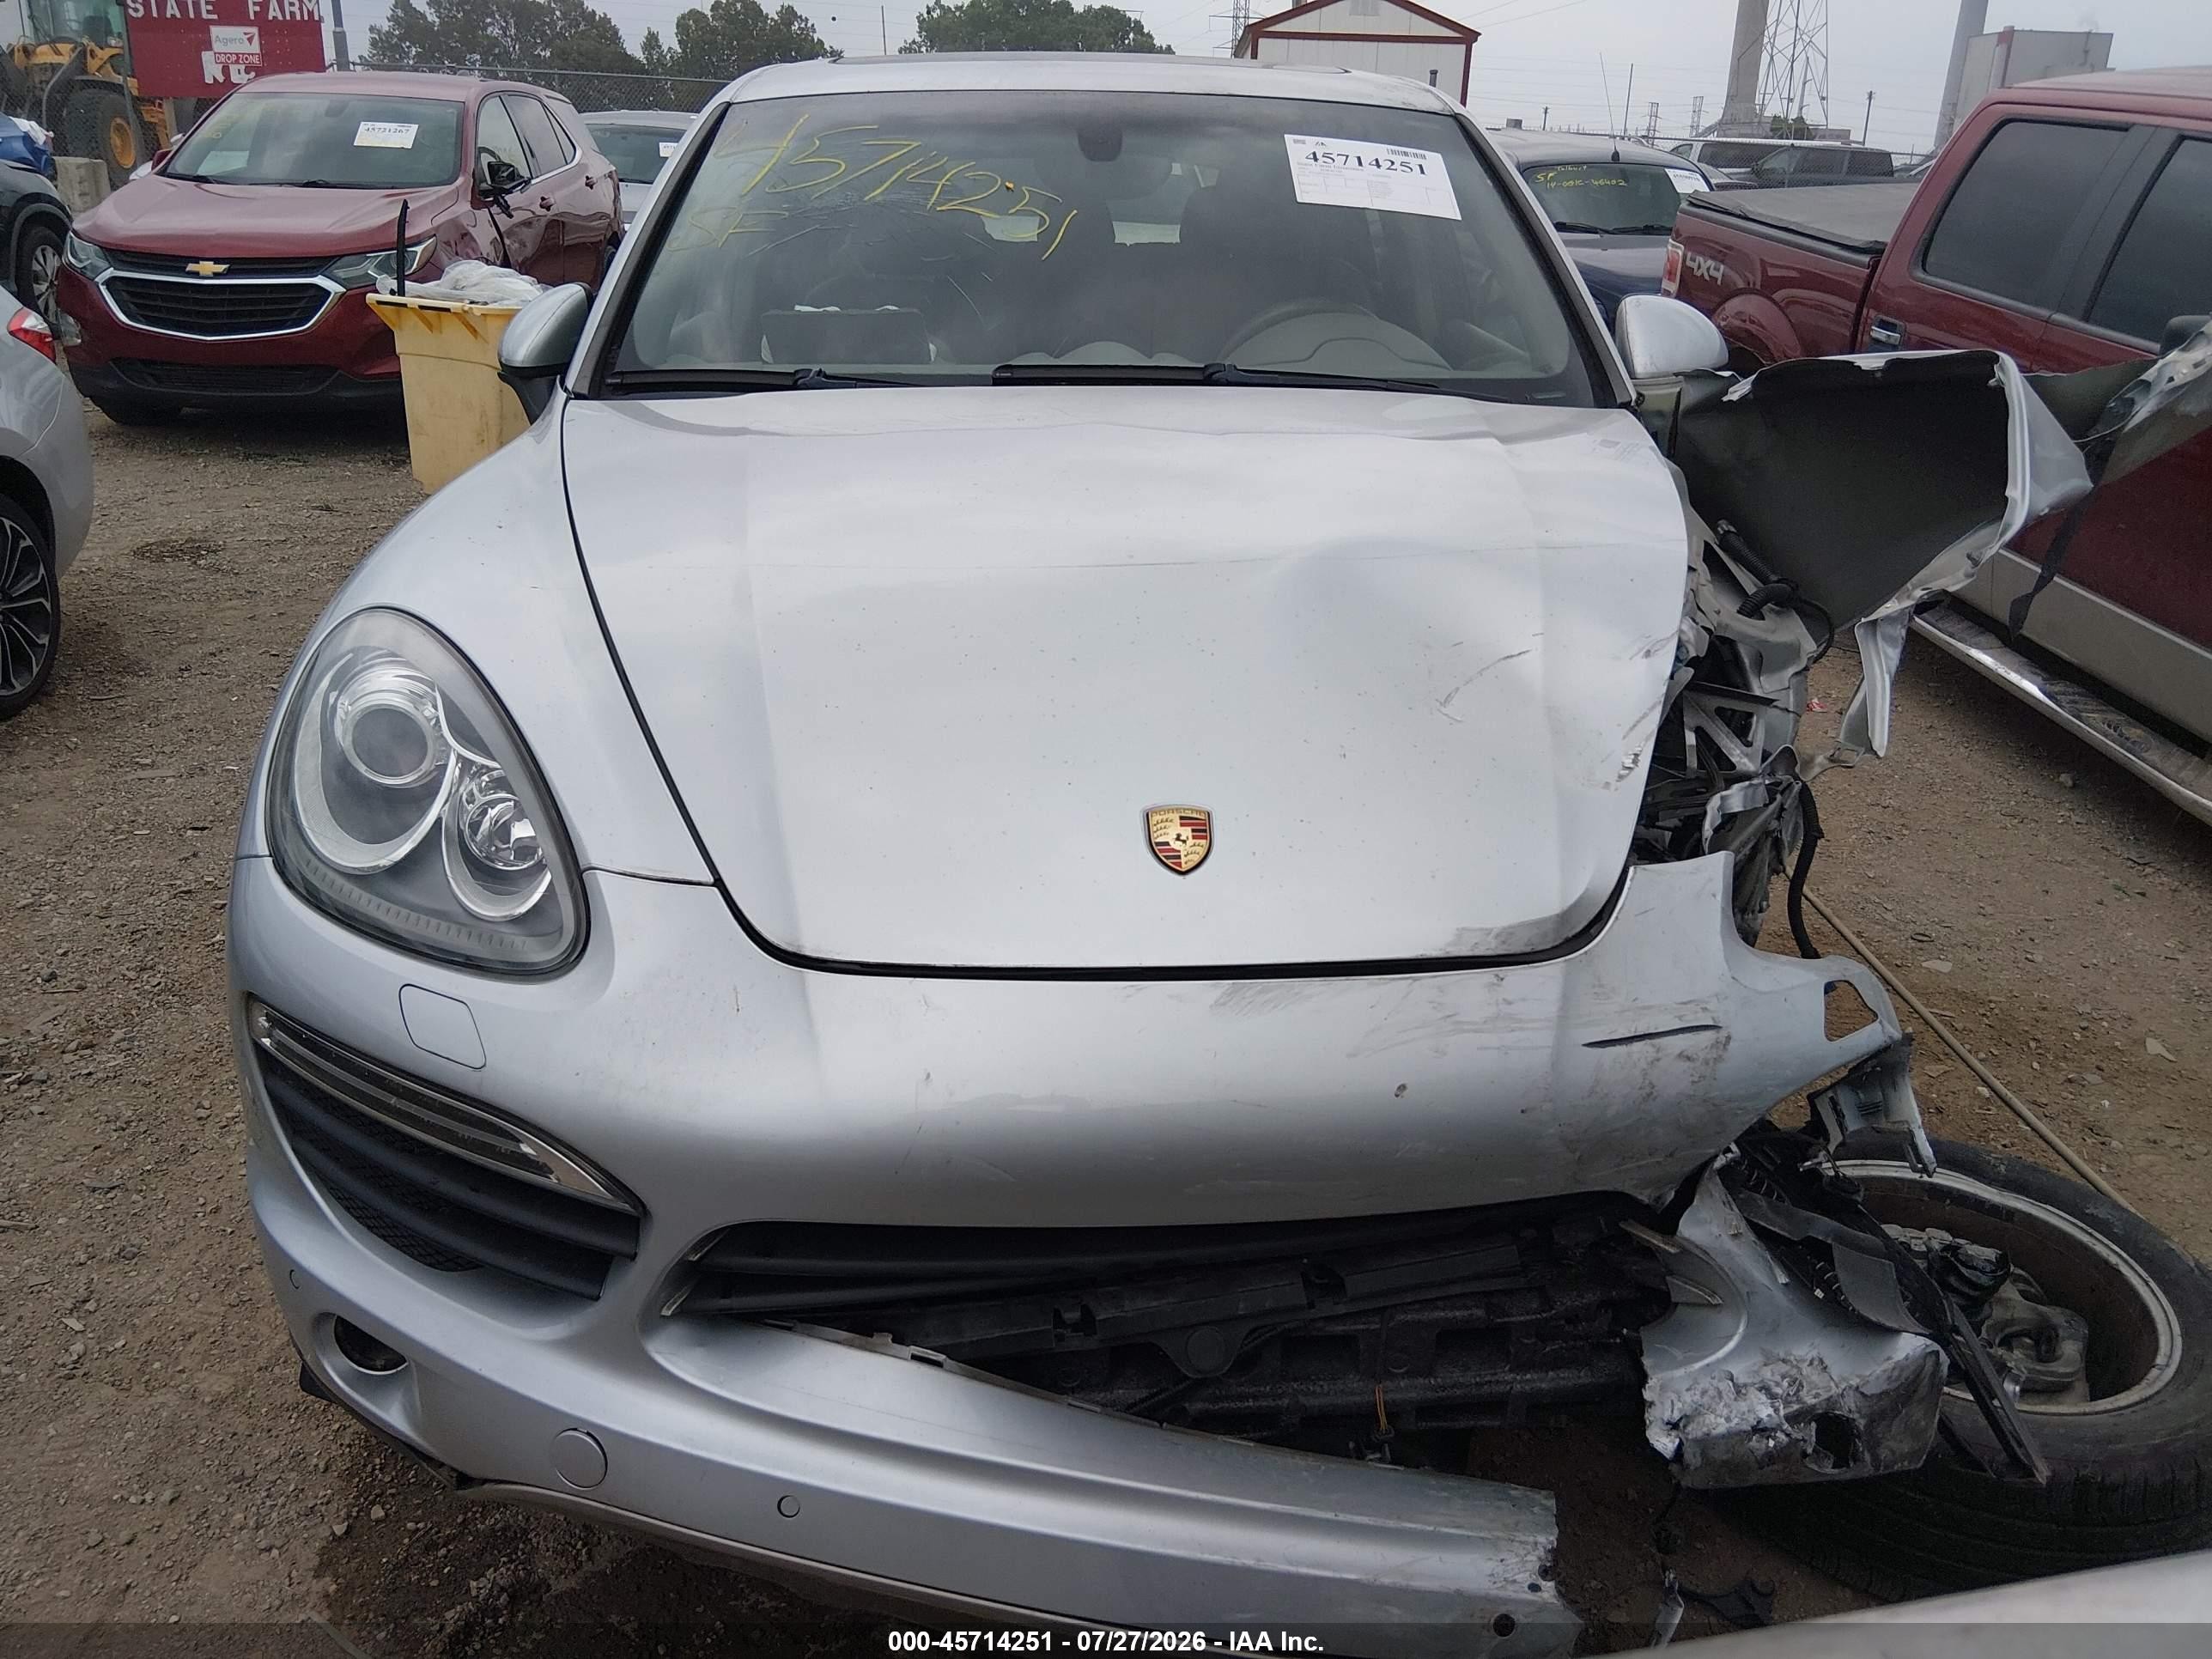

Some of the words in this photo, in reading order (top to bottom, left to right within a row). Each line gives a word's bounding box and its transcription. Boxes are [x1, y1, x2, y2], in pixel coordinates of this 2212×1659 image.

[129, 0, 218, 20] STATE
[249, 0, 319, 21] FARM
[215, 35, 244, 46] Agero
[216, 53, 236, 64] DROP
[238, 54, 260, 64] ZONE
[1304, 150, 1427, 176] 45714251
